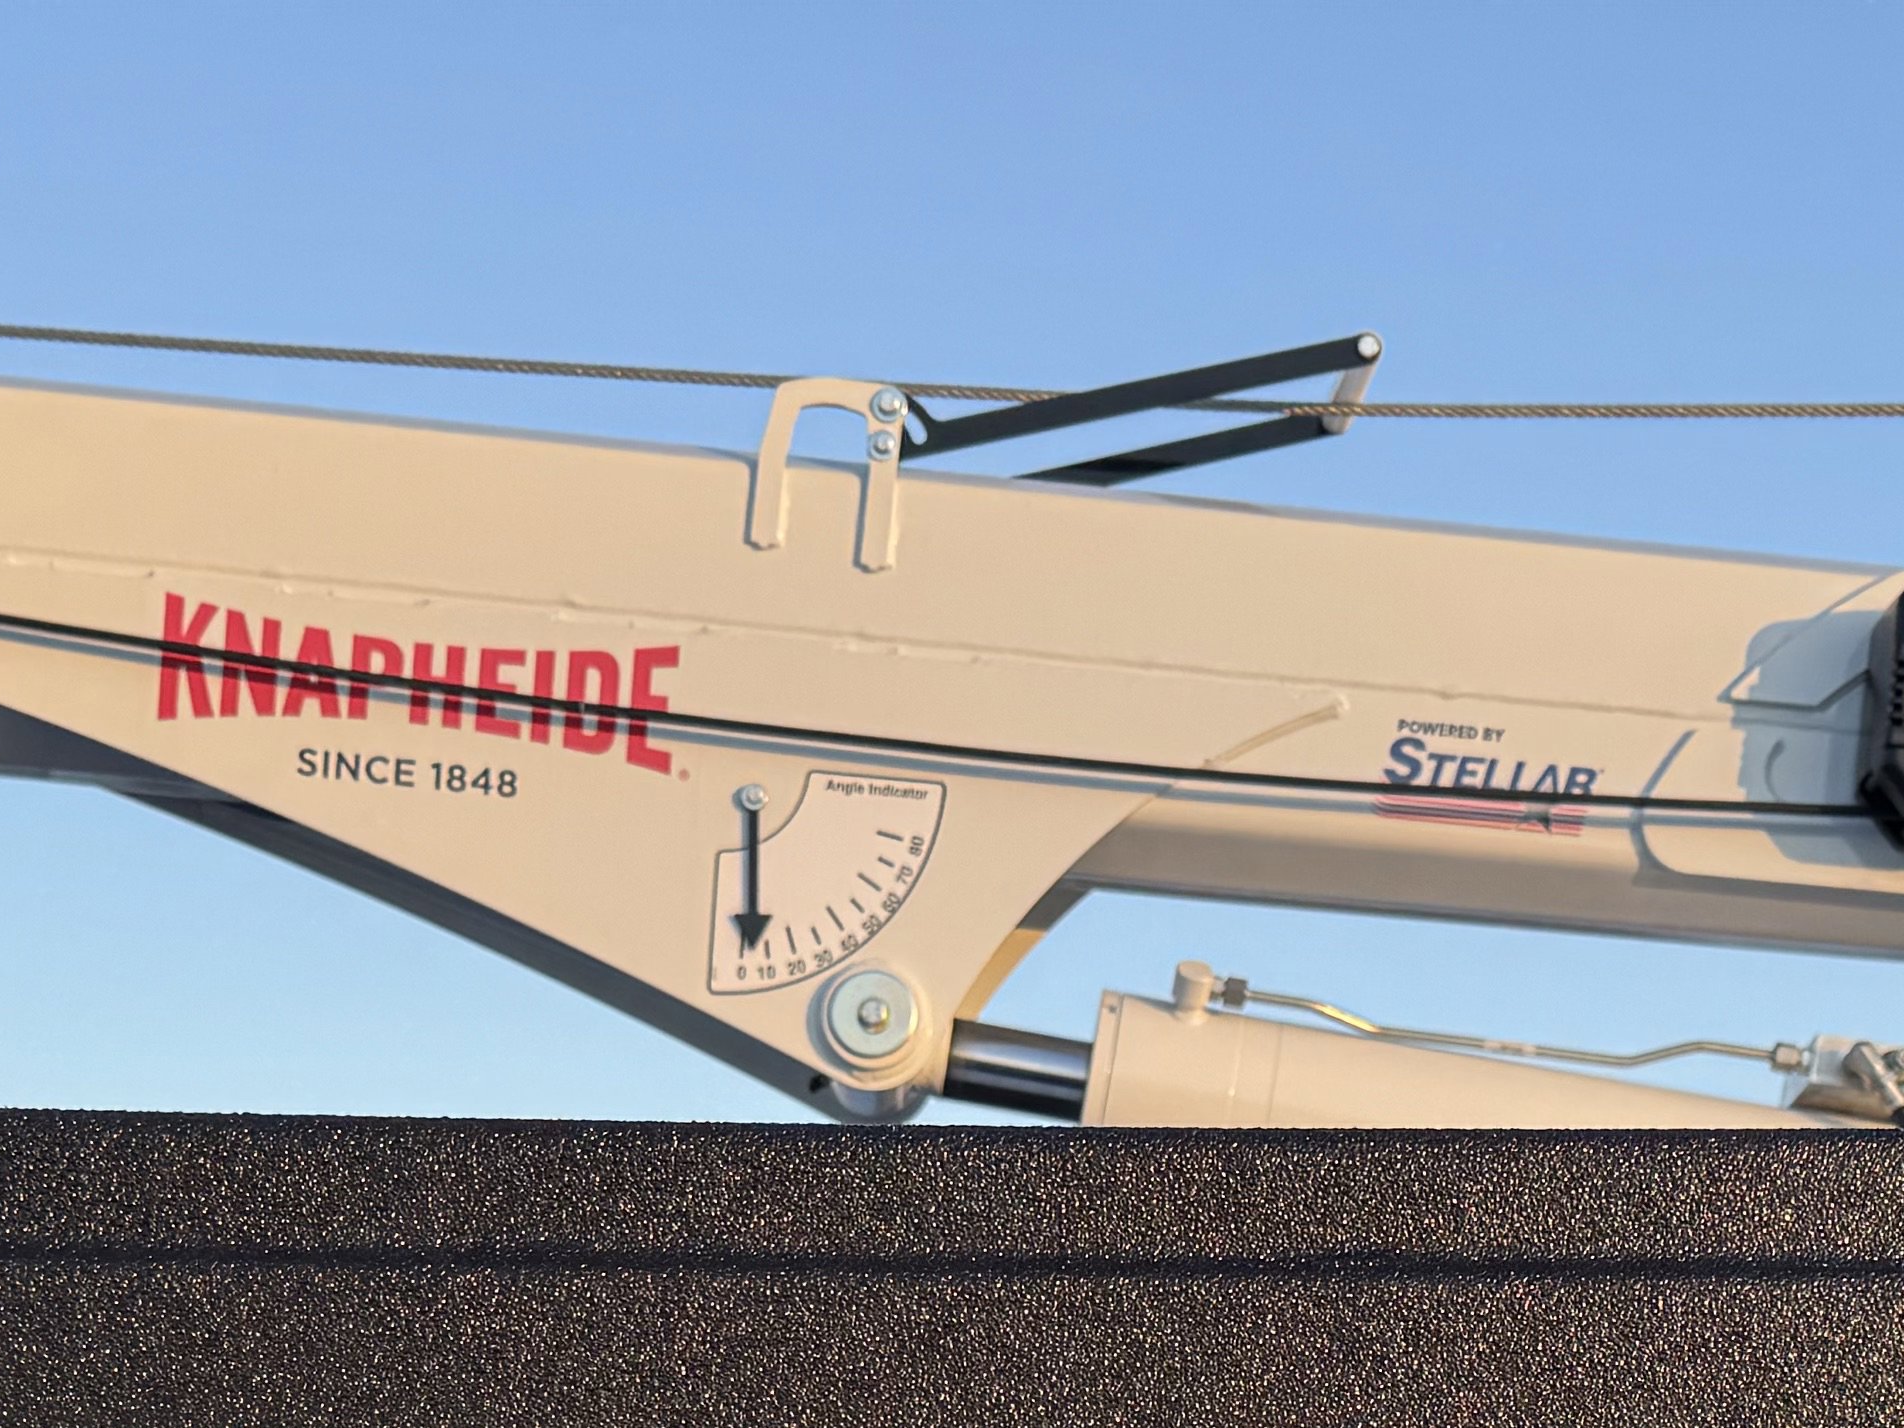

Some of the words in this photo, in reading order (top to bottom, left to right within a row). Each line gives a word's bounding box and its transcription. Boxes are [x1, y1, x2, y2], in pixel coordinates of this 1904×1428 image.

[156, 591, 682, 777] KNAPHEIDE
[1396, 718, 1479, 740] POWERED
[1482, 727, 1506, 743] BY
[296, 747, 417, 788] SINCE
[429, 762, 519, 799] 1848
[825, 779, 865, 796] Angle
[868, 783, 929, 800] Indicator
[1382, 736, 1599, 796] STELLAR
[737, 965, 747, 980] 0
[757, 965, 777, 981] 10
[787, 960, 807, 976] 20
[814, 949, 834, 968] 30
[896, 864, 914, 885] 70
